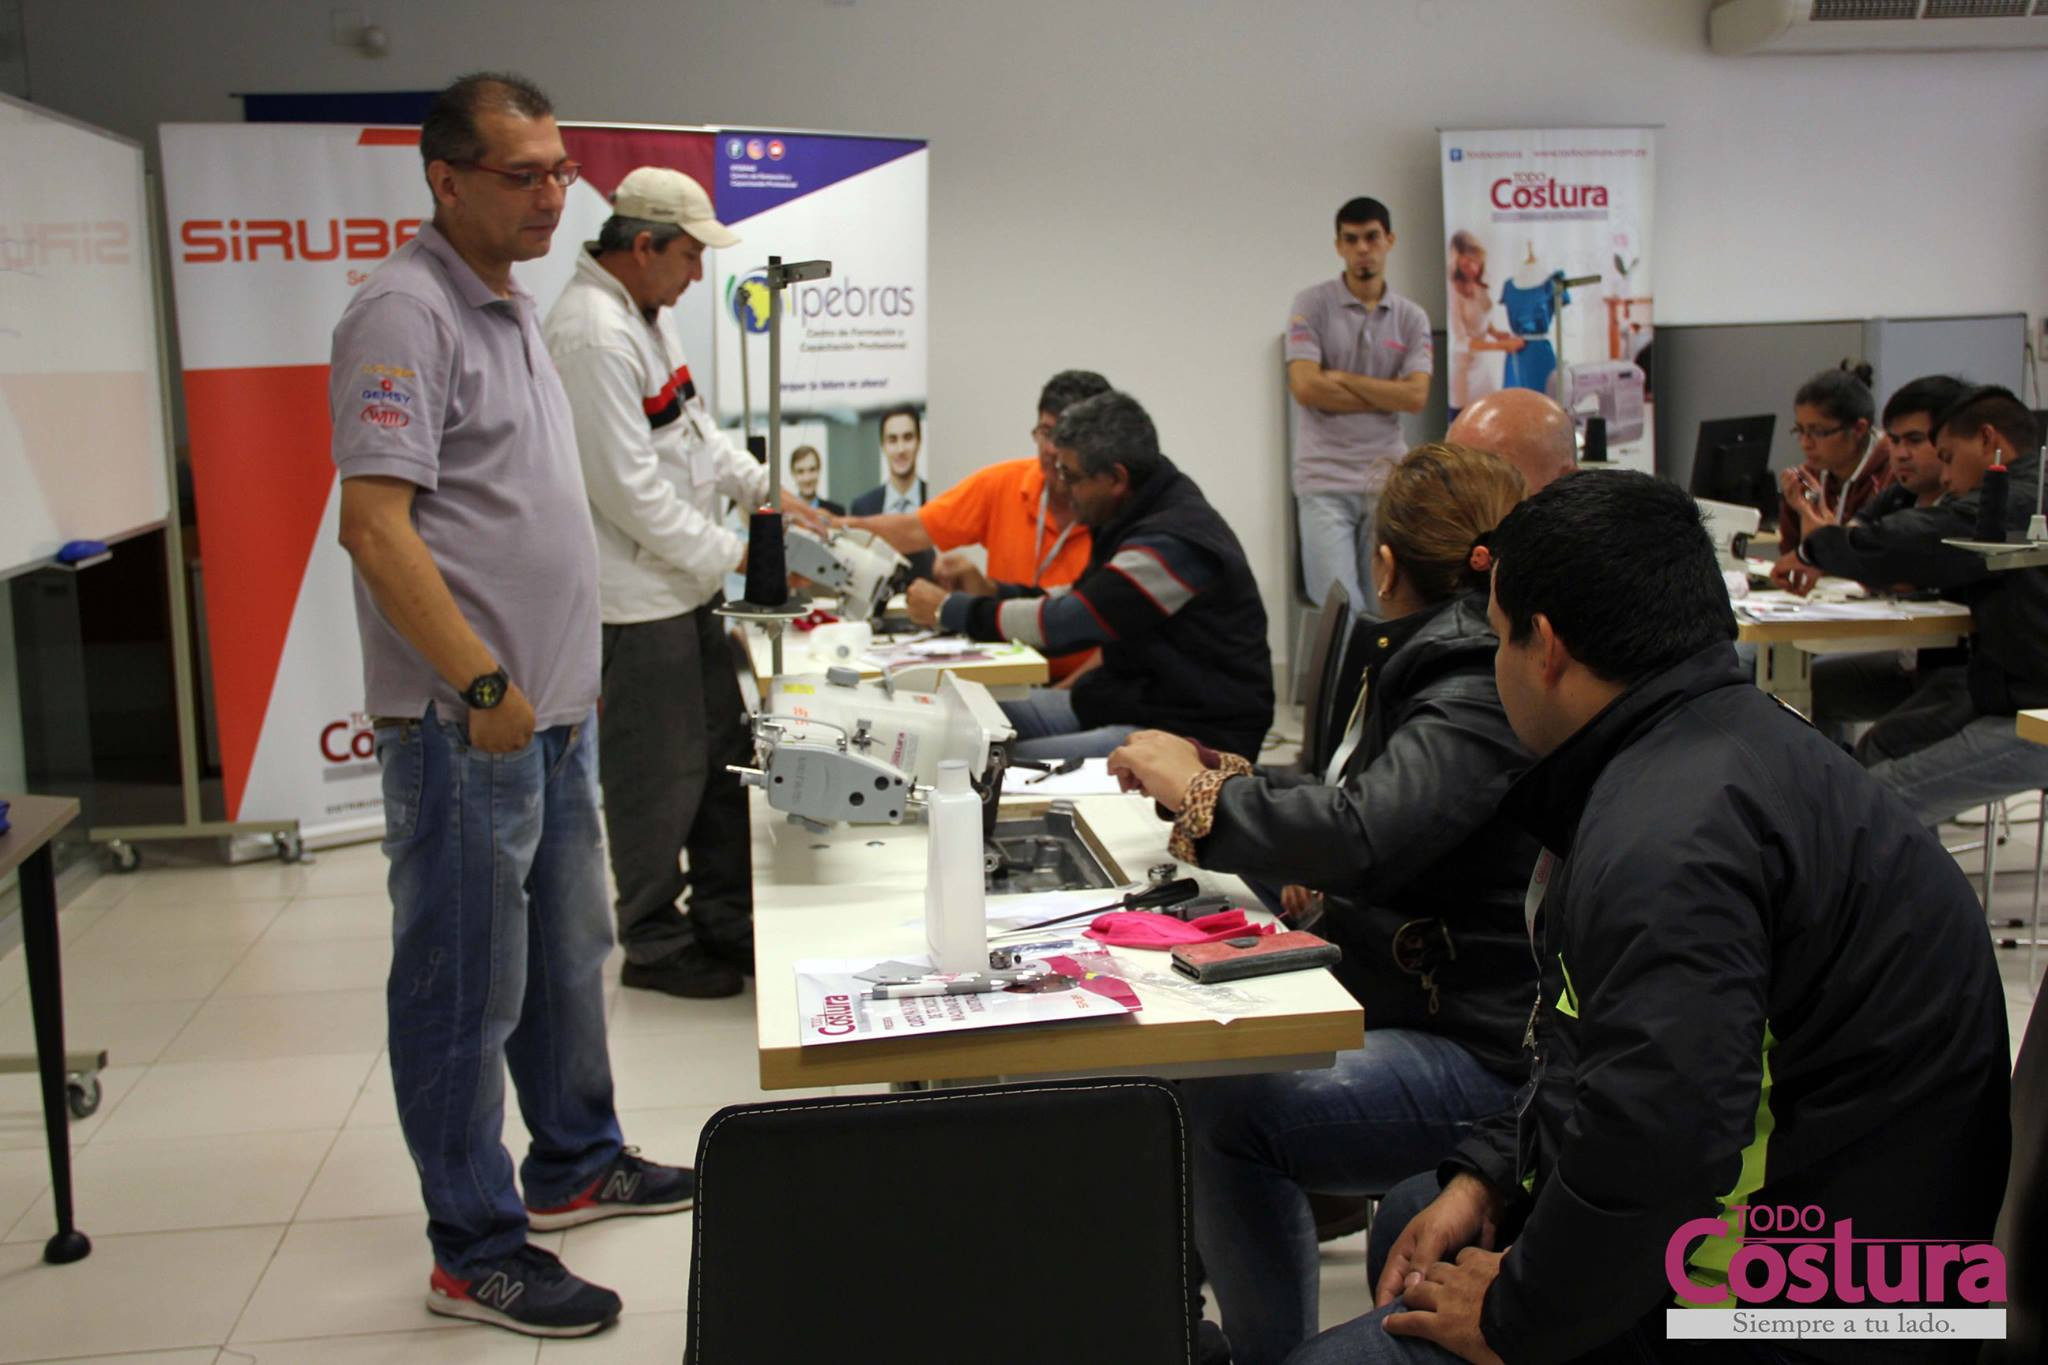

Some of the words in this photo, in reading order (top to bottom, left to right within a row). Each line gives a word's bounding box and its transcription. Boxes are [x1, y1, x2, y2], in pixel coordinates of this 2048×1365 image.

[1491, 178, 1608, 209] Costura
[1513, 171, 1546, 183] TODO
[818, 994, 856, 1036] Costura
[477, 1271, 524, 1310] N
